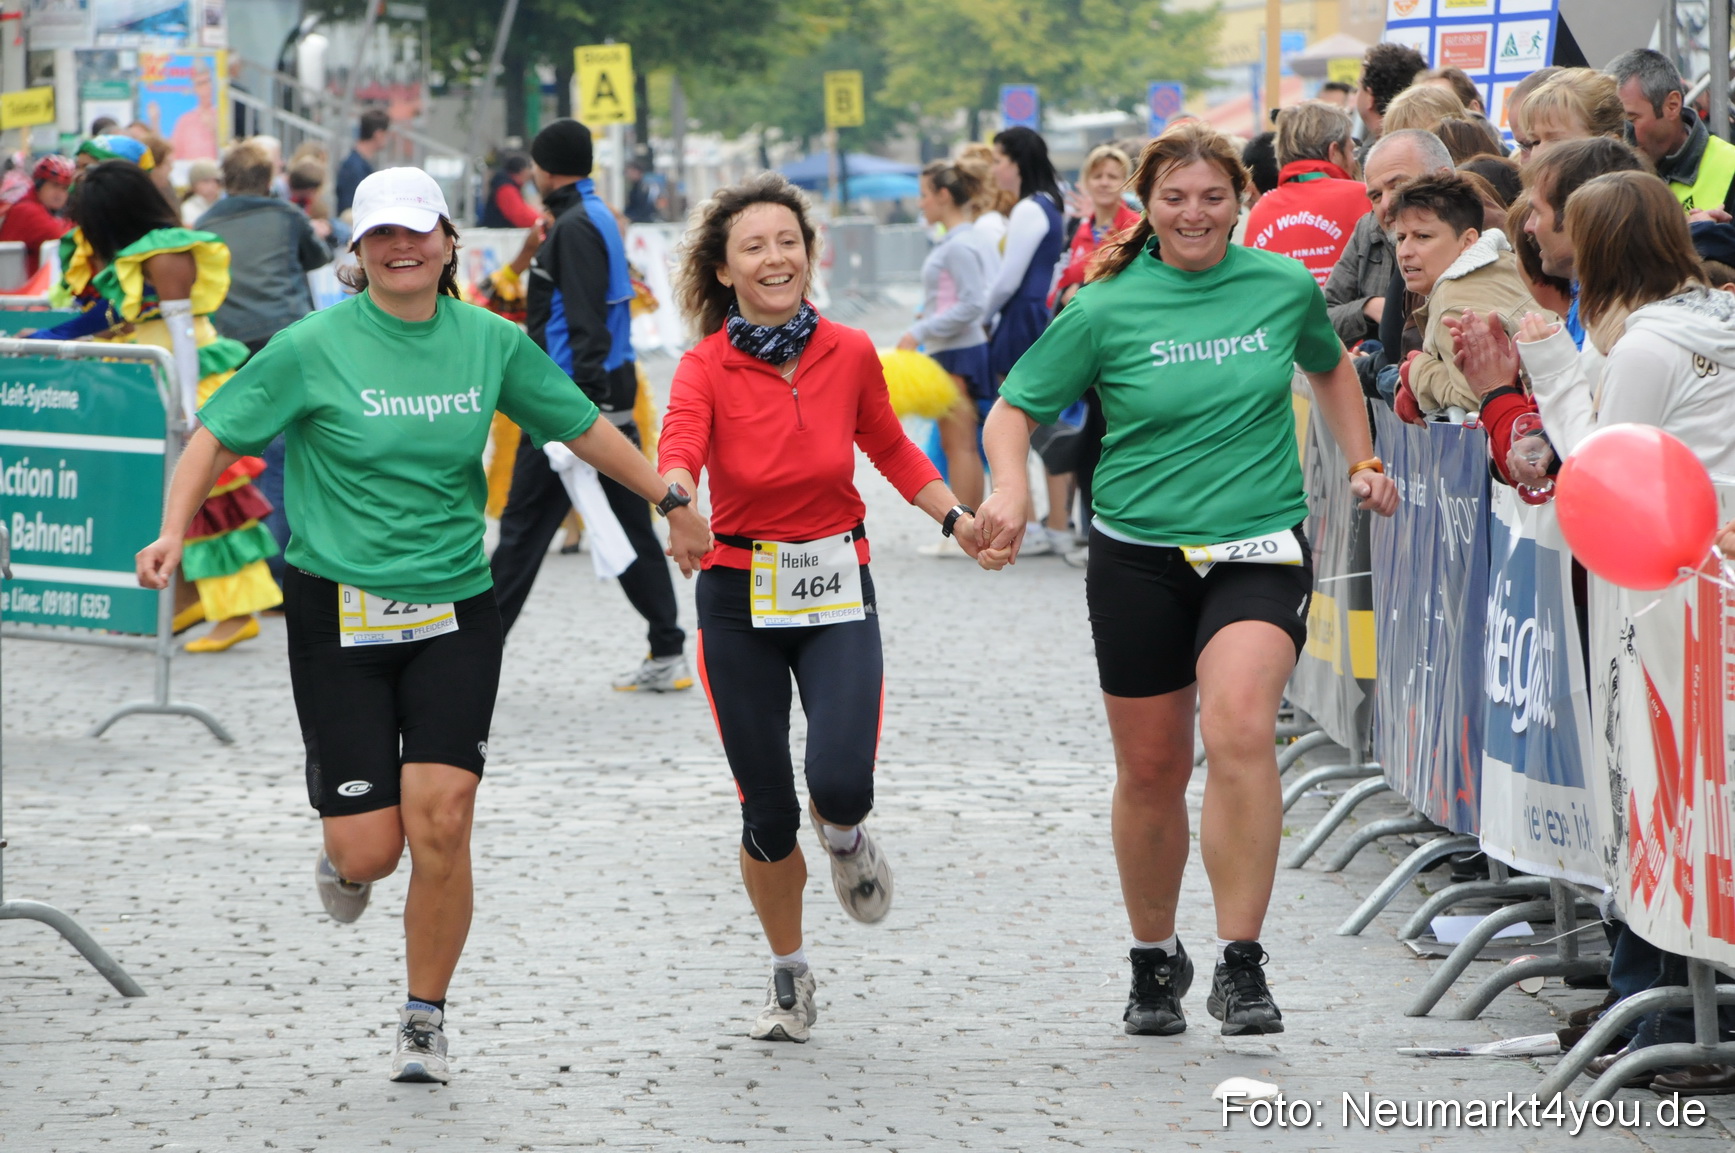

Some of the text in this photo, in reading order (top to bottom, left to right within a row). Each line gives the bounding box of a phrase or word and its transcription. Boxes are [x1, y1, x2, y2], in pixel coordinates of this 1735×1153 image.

[592, 73, 620, 106] A
[835, 87, 851, 113] B
[1276, 211, 1343, 240] Wolfstein
[58, 459, 78, 499] in
[11, 511, 94, 555] Bahnen!
[781, 552, 819, 568] Heike
[1225, 540, 1279, 560] 220
[755, 575, 763, 587] D
[791, 572, 842, 600] 464
[11, 587, 41, 613] Line:
[42, 590, 78, 616] 09181
[80, 593, 111, 619] 6352
[382, 597, 432, 615] 22
[820, 608, 862, 619] PFLEIDERER
[414, 617, 455, 635] PFLEIDERER
